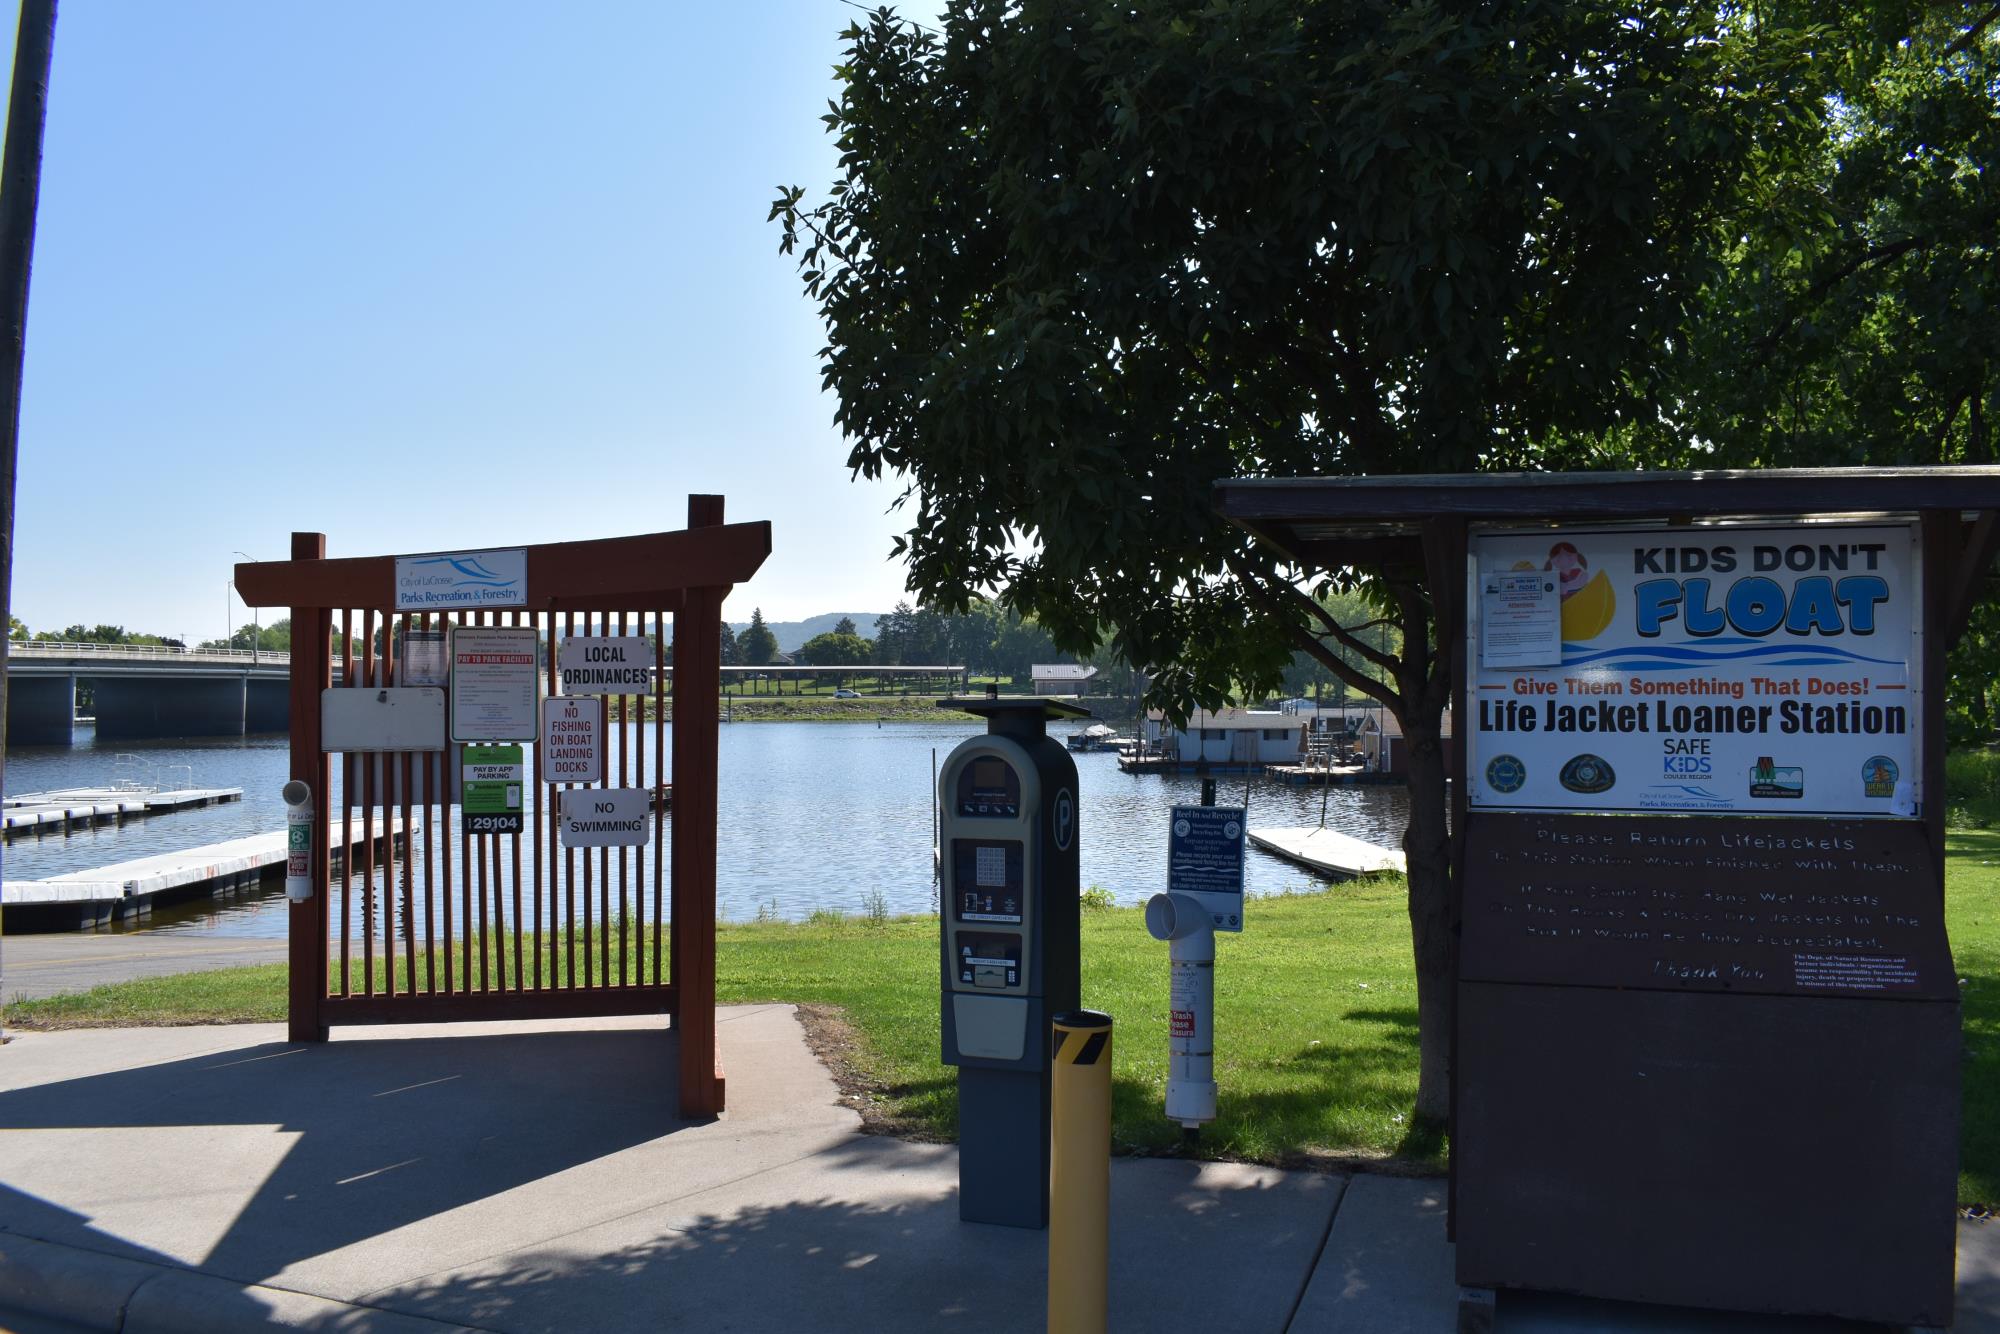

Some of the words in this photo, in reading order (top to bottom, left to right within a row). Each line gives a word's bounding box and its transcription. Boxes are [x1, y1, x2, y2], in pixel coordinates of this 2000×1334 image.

[1634, 545, 1737, 573] KIDS
[1753, 544, 1885, 572] DON'T
[400, 577, 412, 588] City
[414, 576, 422, 586] of
[474, 590, 481, 600] &
[482, 588, 518, 600] Forestry
[1634, 576, 1889, 637] FLOAT
[585, 647, 626, 662] LOCAL
[564, 669, 648, 684] ORDINANCES
[1513, 678, 1557, 695] Give
[1565, 678, 1624, 695] Them
[1630, 678, 1744, 698] Something
[1751, 678, 1801, 695] That
[1807, 678, 1869, 695] Does!
[565, 708, 578, 718] NO
[1480, 700, 1536, 732] Life
[1544, 700, 1649, 732] Jacket
[1658, 700, 1772, 732] Loaner
[1780, 700, 1906, 732] Station
[552, 721, 590, 732] FISHING
[550, 735, 564, 746] ON
[568, 735, 592, 745] BOAT
[1664, 738, 1711, 754] SAFE
[550, 748, 592, 759] LANDING
[556, 762, 588, 772] DOCKS
[1664, 757, 1711, 772] KIDS
[595, 803, 614, 813] NO
[1176, 810, 1192, 818] Reel
[1192, 811, 1200, 819] In
[472, 816, 518, 830] 29104
[570, 820, 642, 832] SWIMMING
[1060, 800, 1070, 842] P
[1538, 829, 1613, 845] Please
[1630, 832, 1706, 846] Return
[1722, 834, 1855, 850] Lifejackets
[1760, 891, 1793, 904] Wet
[1654, 960, 1720, 978] Thank
[1173, 1012, 1192, 1020] Trash
